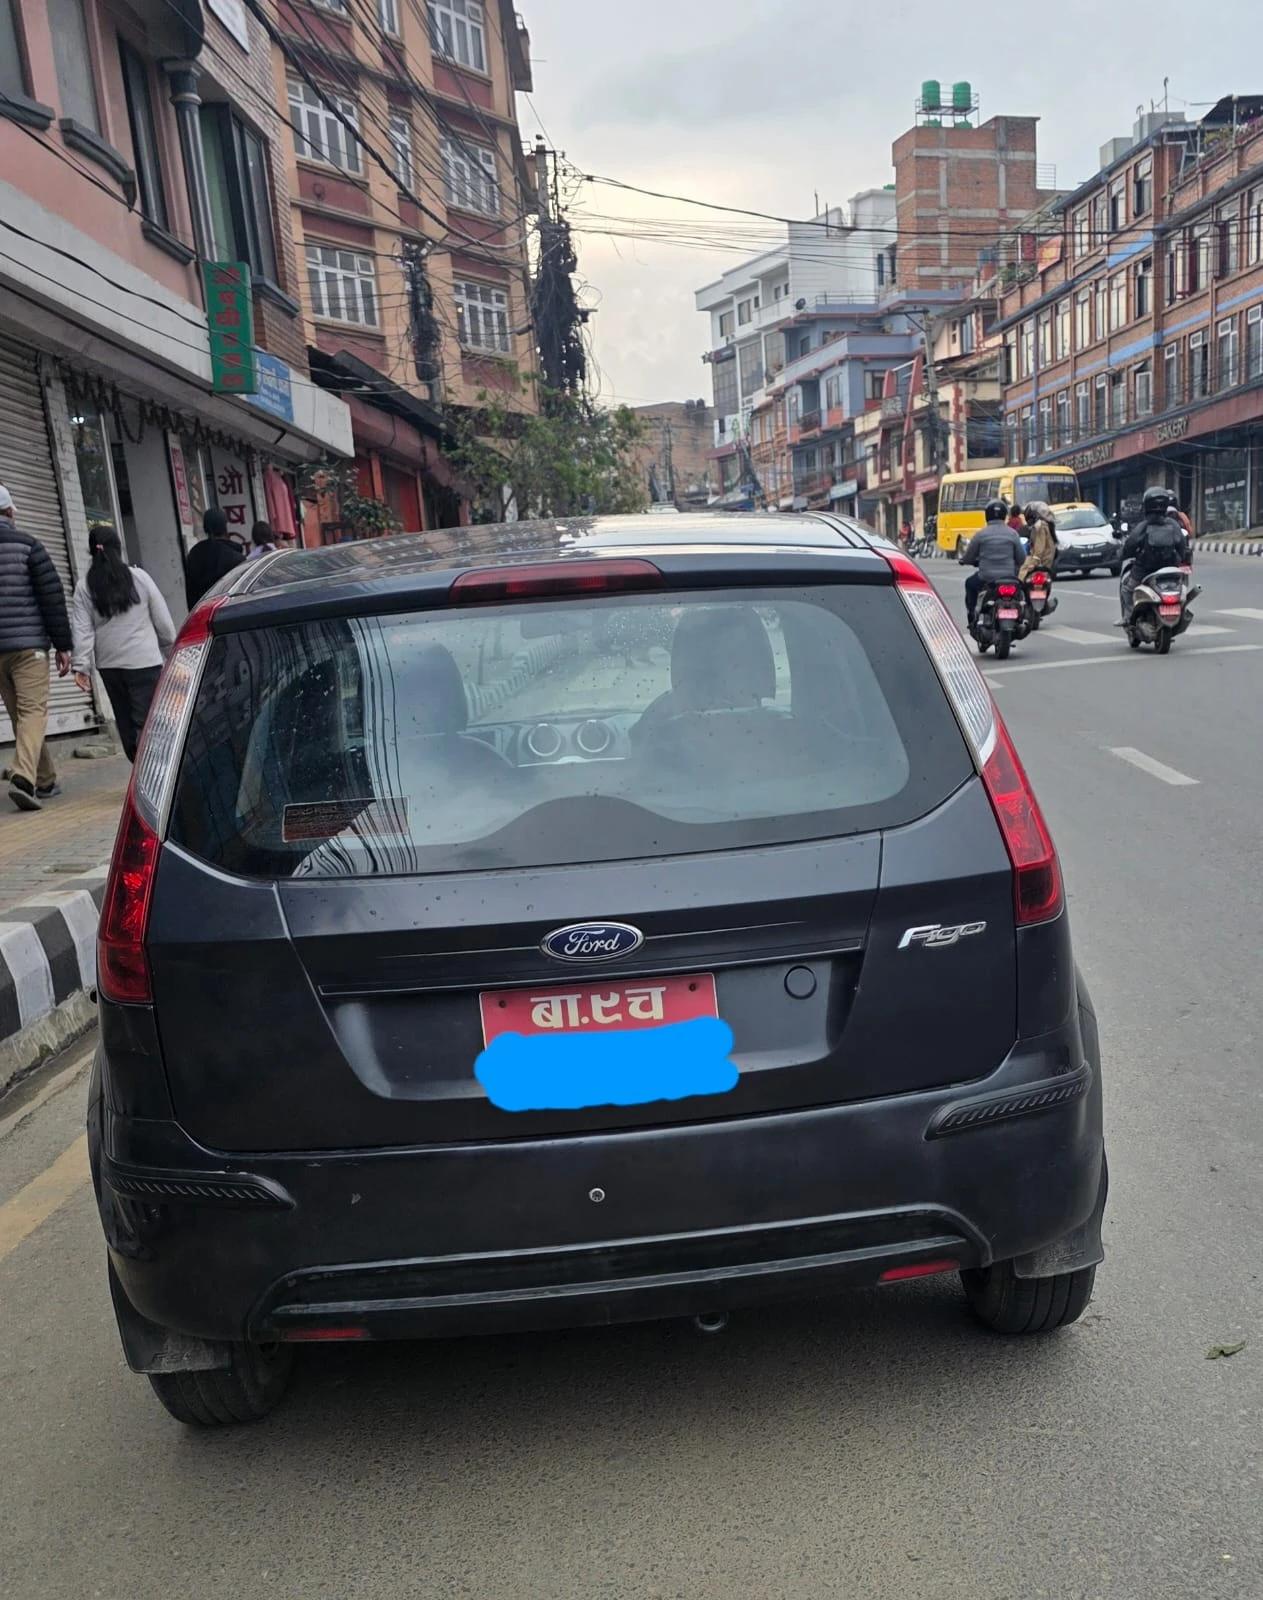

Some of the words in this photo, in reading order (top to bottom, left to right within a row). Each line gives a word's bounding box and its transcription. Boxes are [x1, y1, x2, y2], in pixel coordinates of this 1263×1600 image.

[1155, 415, 1189, 441] BAKERY
[563, 928, 621, 956] Ford
[897, 921, 987, 949] Figo
